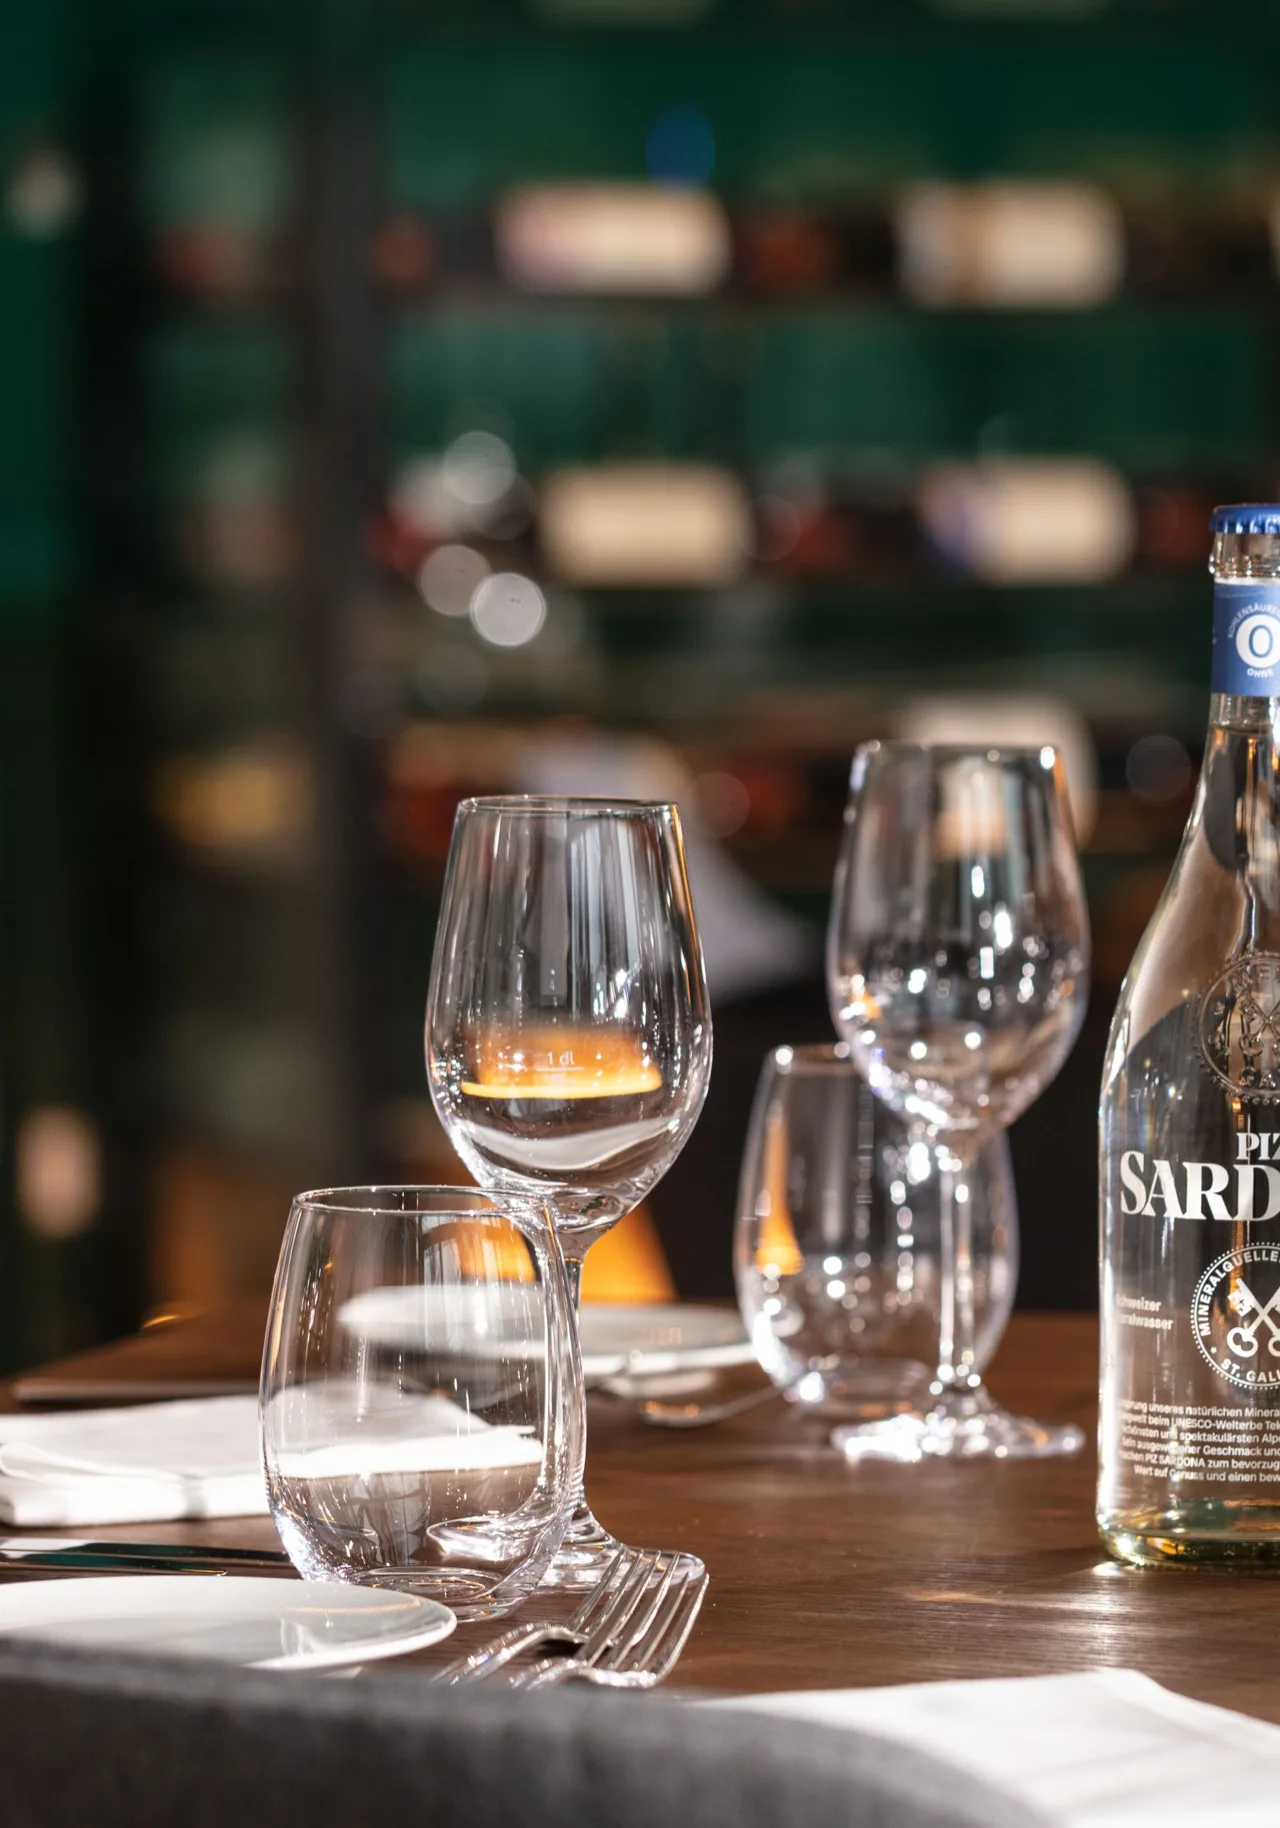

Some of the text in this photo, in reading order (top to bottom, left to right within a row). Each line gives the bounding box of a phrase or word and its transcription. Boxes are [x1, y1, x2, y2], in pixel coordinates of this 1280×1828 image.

[1247, 668, 1274, 678] OHNE
[547, 1050, 574, 1066] 1 dl
[1221, 1359, 1241, 1378] ST.
[1149, 1403, 1184, 1415] unseres
[1185, 1406, 1243, 1417] natürlichen
[1148, 1415, 1169, 1426] beim
[1171, 1418, 1263, 1430] UNESCO-Welterbe
[1180, 1431, 1259, 1443] spektakulärsten
[1203, 1445, 1262, 1456] Geschmack
[1145, 1453, 1158, 1464] PIZ
[1159, 1455, 1205, 1467] SARDONA
[1207, 1459, 1229, 1468] zum
[1206, 1471, 1226, 1481] und
[1228, 1471, 1257, 1482] einen
